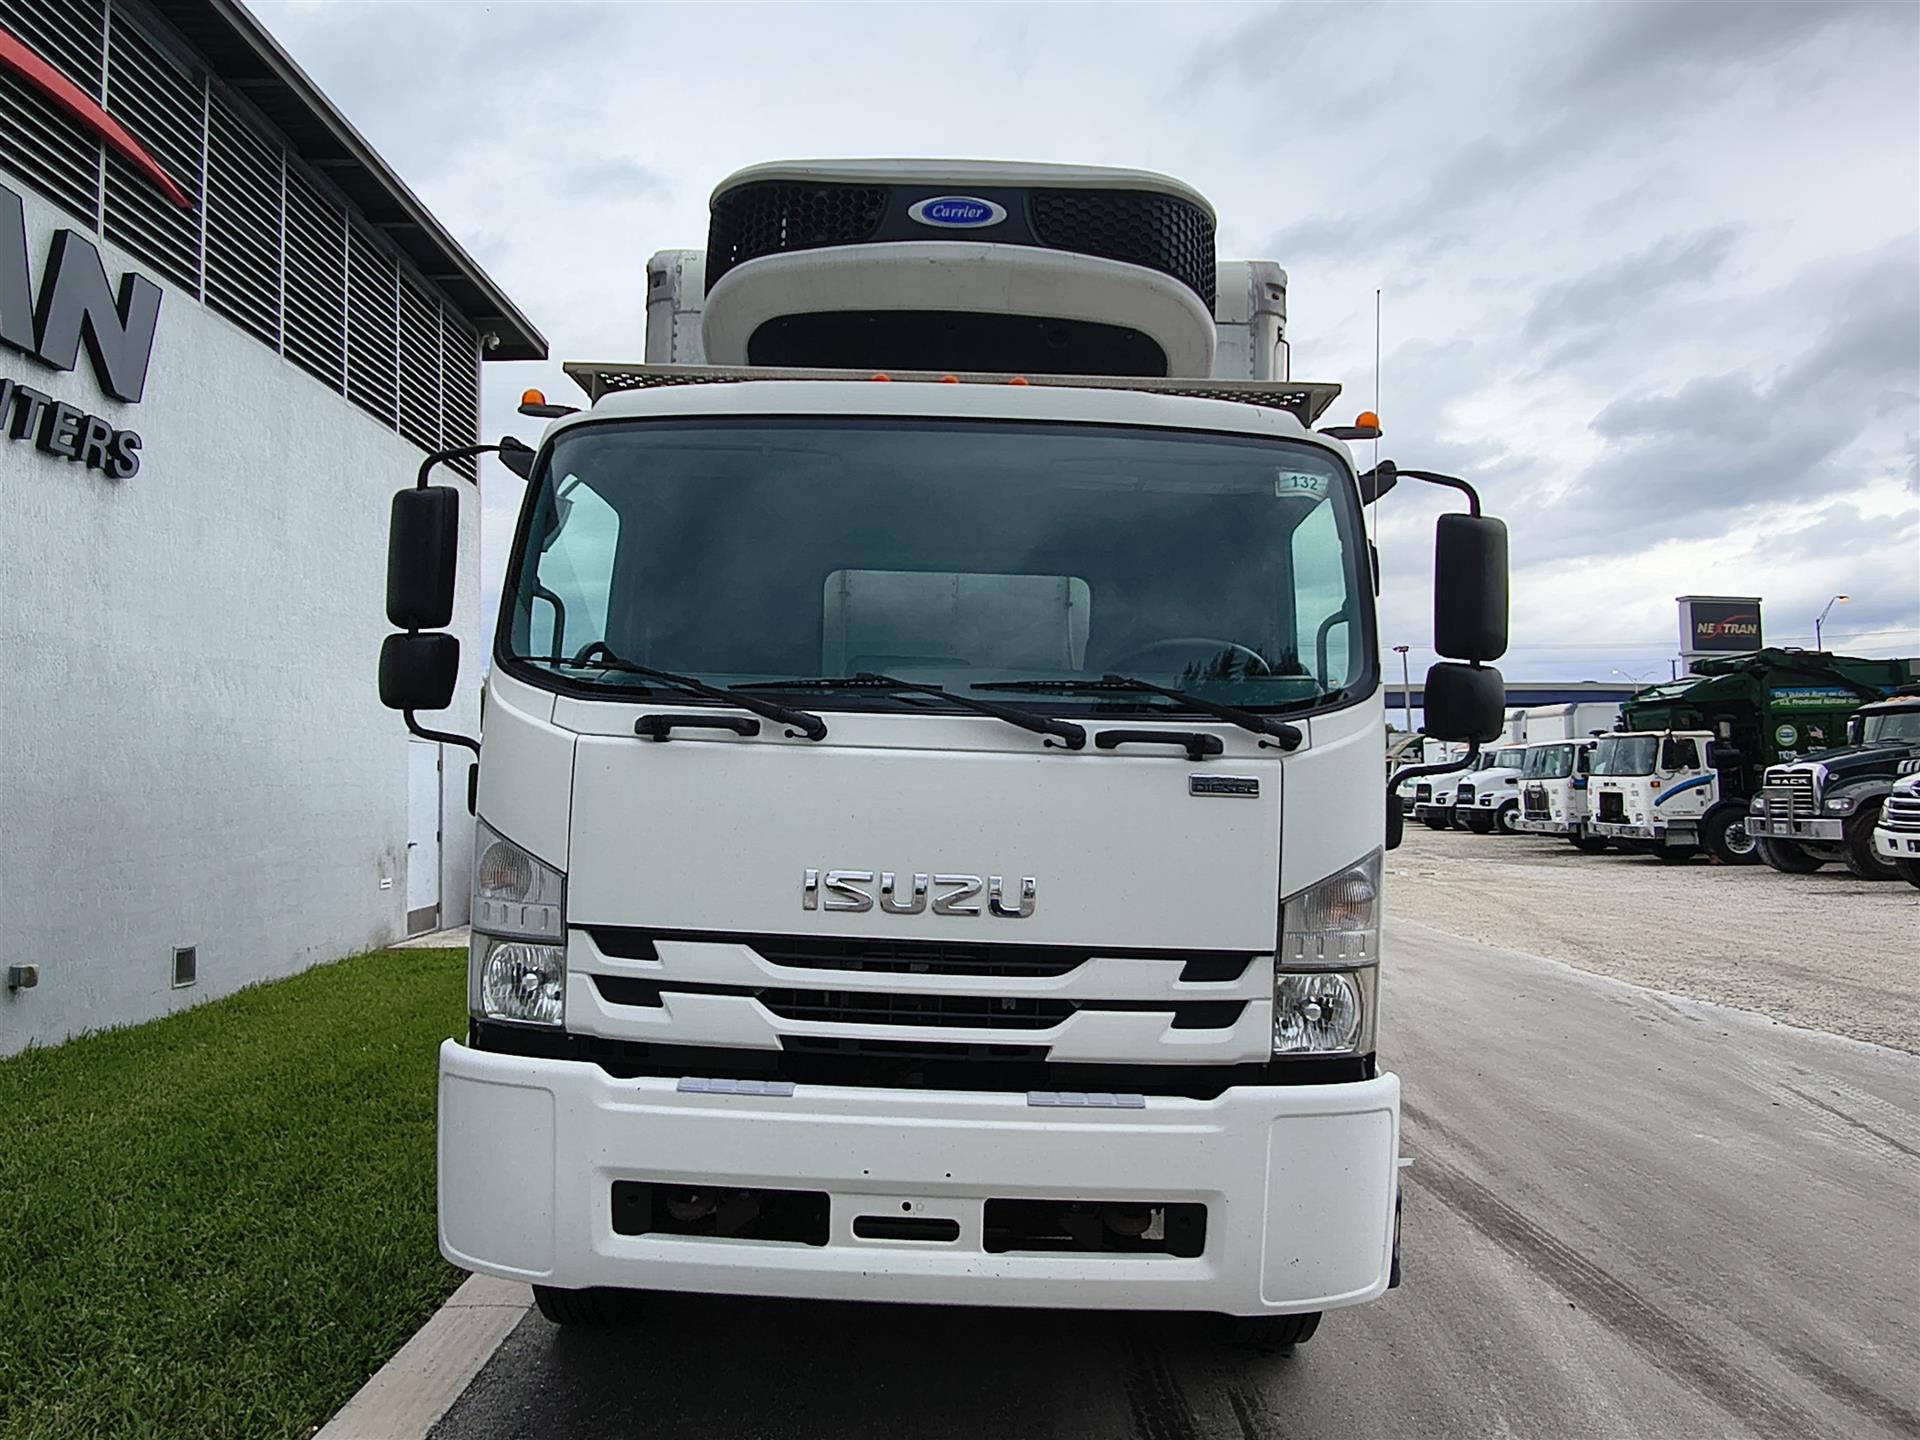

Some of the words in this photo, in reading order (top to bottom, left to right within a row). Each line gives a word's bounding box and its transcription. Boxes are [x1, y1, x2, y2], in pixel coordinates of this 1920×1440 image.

[931, 205, 984, 218] Carrier
[1291, 475, 1318, 490] 132
[803, 868, 1036, 918] ISUZU
